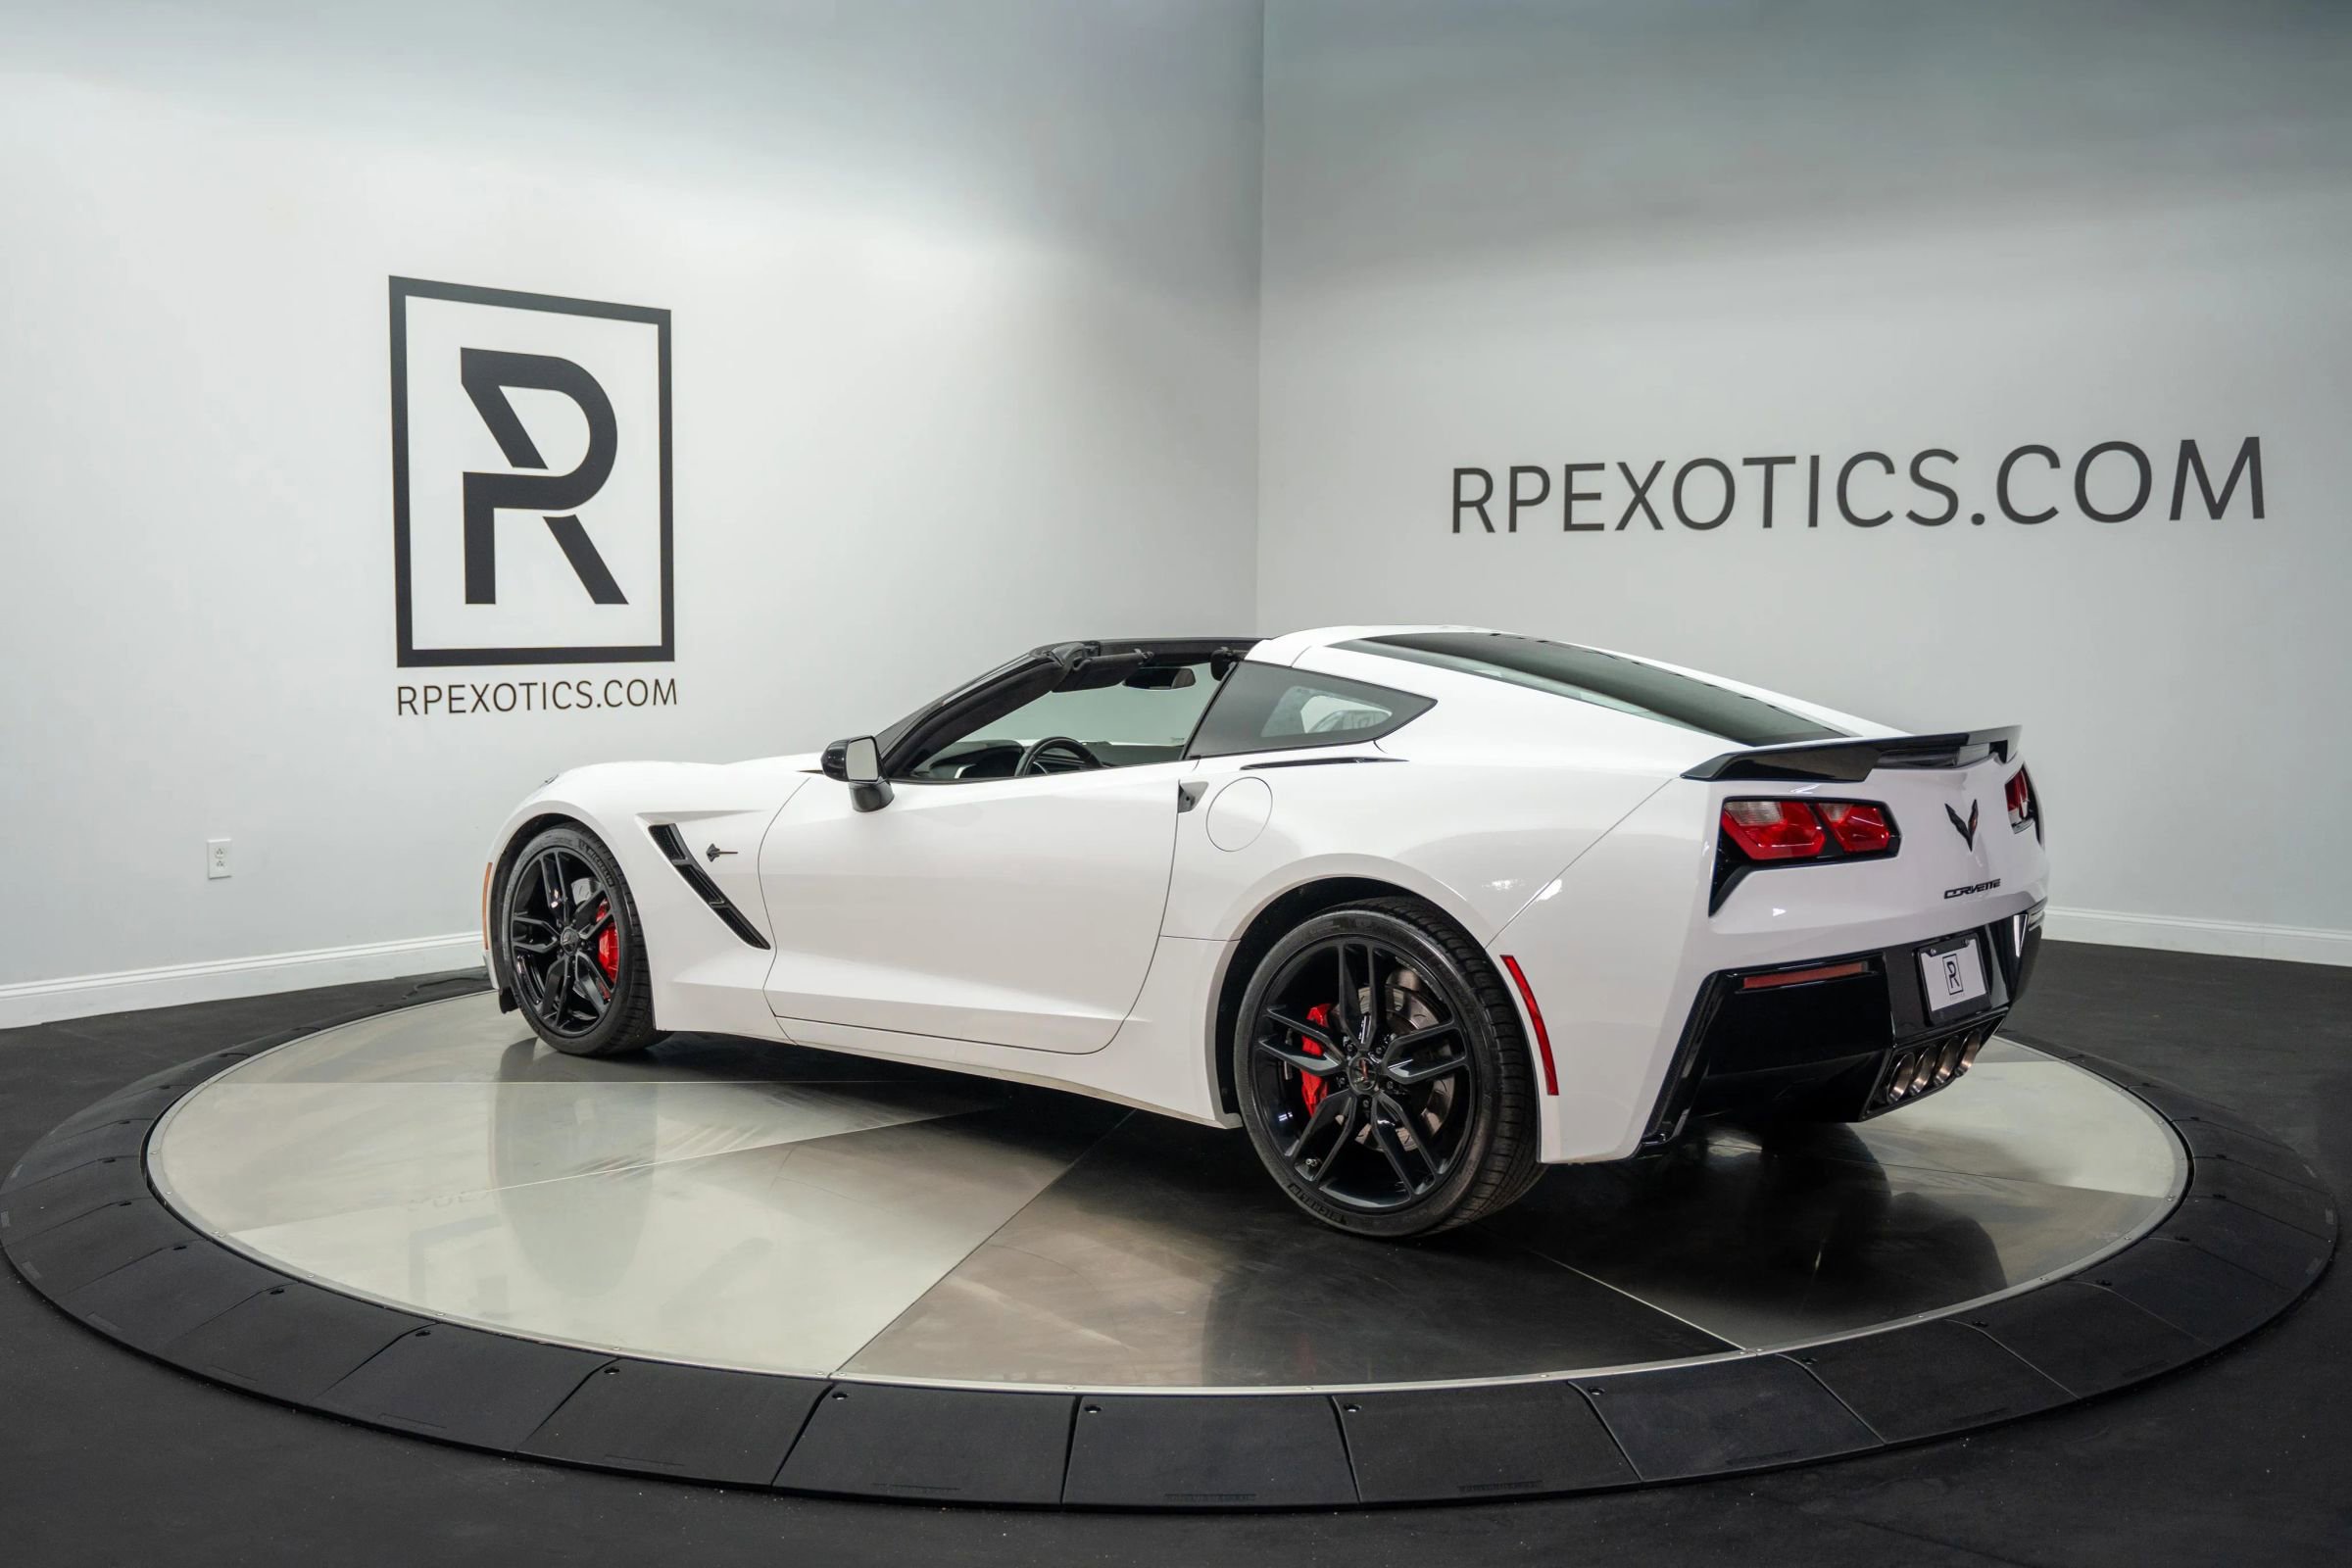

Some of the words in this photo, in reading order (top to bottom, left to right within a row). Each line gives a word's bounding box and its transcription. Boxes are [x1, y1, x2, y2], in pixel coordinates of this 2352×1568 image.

[1451, 436, 2266, 533] RPEXOTICS.COM
[397, 678, 677, 716] RPEXOTICS.COM
[1943, 878, 2001, 900] CORVETTE
